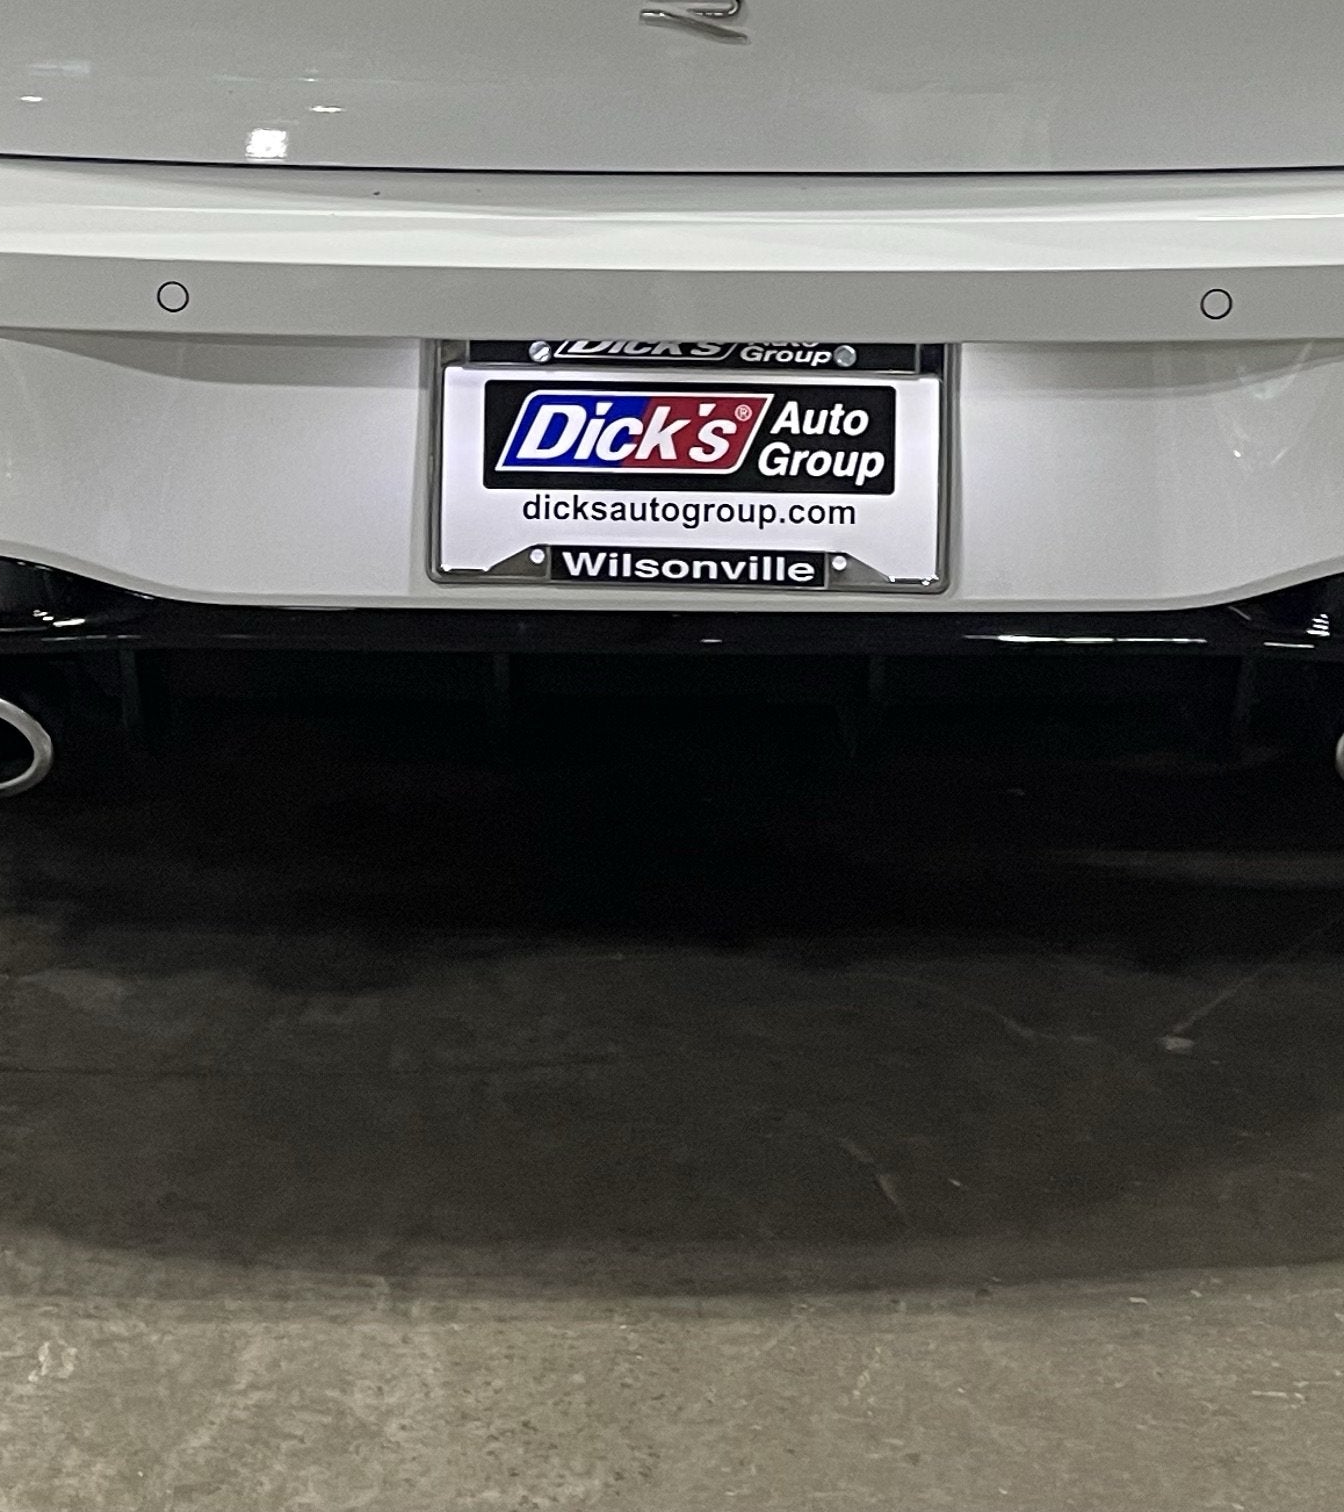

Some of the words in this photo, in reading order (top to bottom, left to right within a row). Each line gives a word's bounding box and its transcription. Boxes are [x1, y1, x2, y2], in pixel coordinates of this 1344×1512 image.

[738, 346, 833, 368] Group
[515, 400, 739, 464] Dick's
[769, 400, 870, 437] Auto
[757, 442, 886, 486] Group
[522, 493, 857, 530] dicksautogroup.com
[561, 551, 816, 583] Wilsonville
